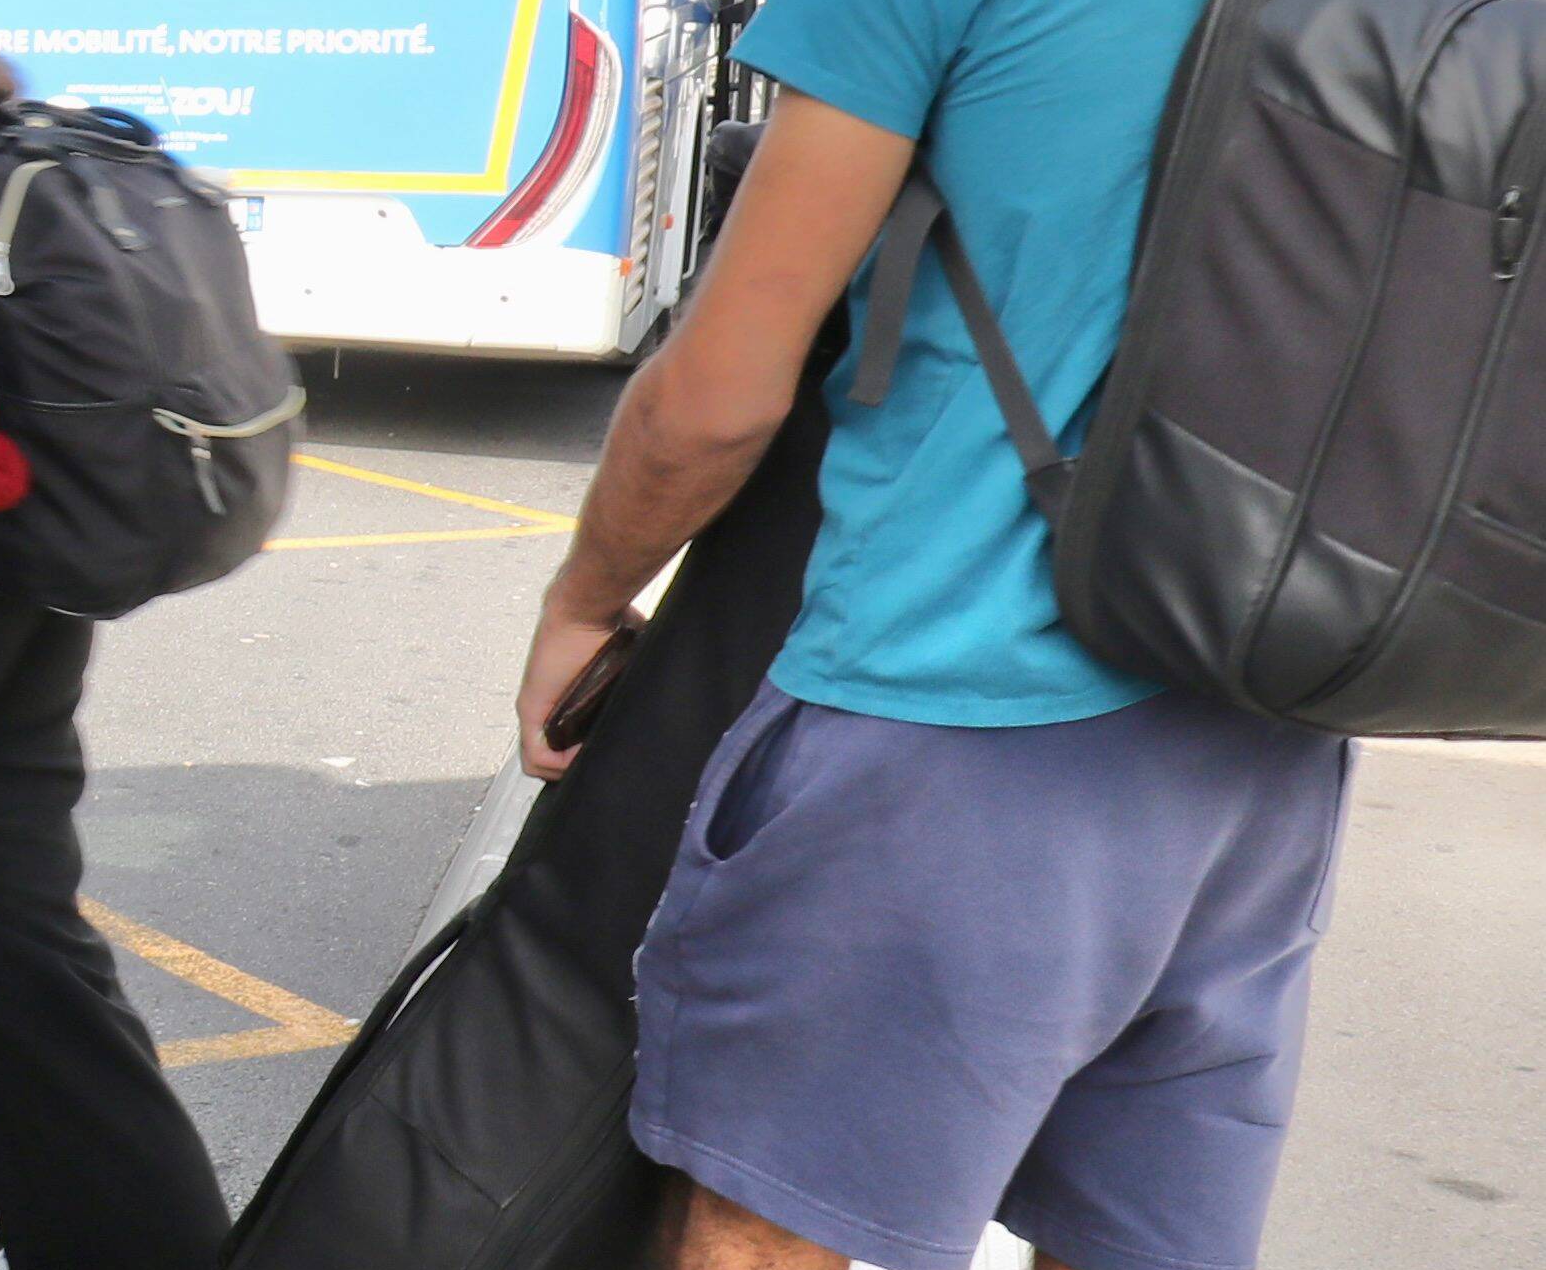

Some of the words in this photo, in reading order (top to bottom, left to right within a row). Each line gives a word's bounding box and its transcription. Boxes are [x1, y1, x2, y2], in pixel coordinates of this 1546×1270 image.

[33, 22, 176, 58] MOBILITÉ,
[179, 28, 282, 55] NOTRE
[286, 22, 435, 55] PRIORITÉ.
[169, 85, 255, 116] ZOU!
